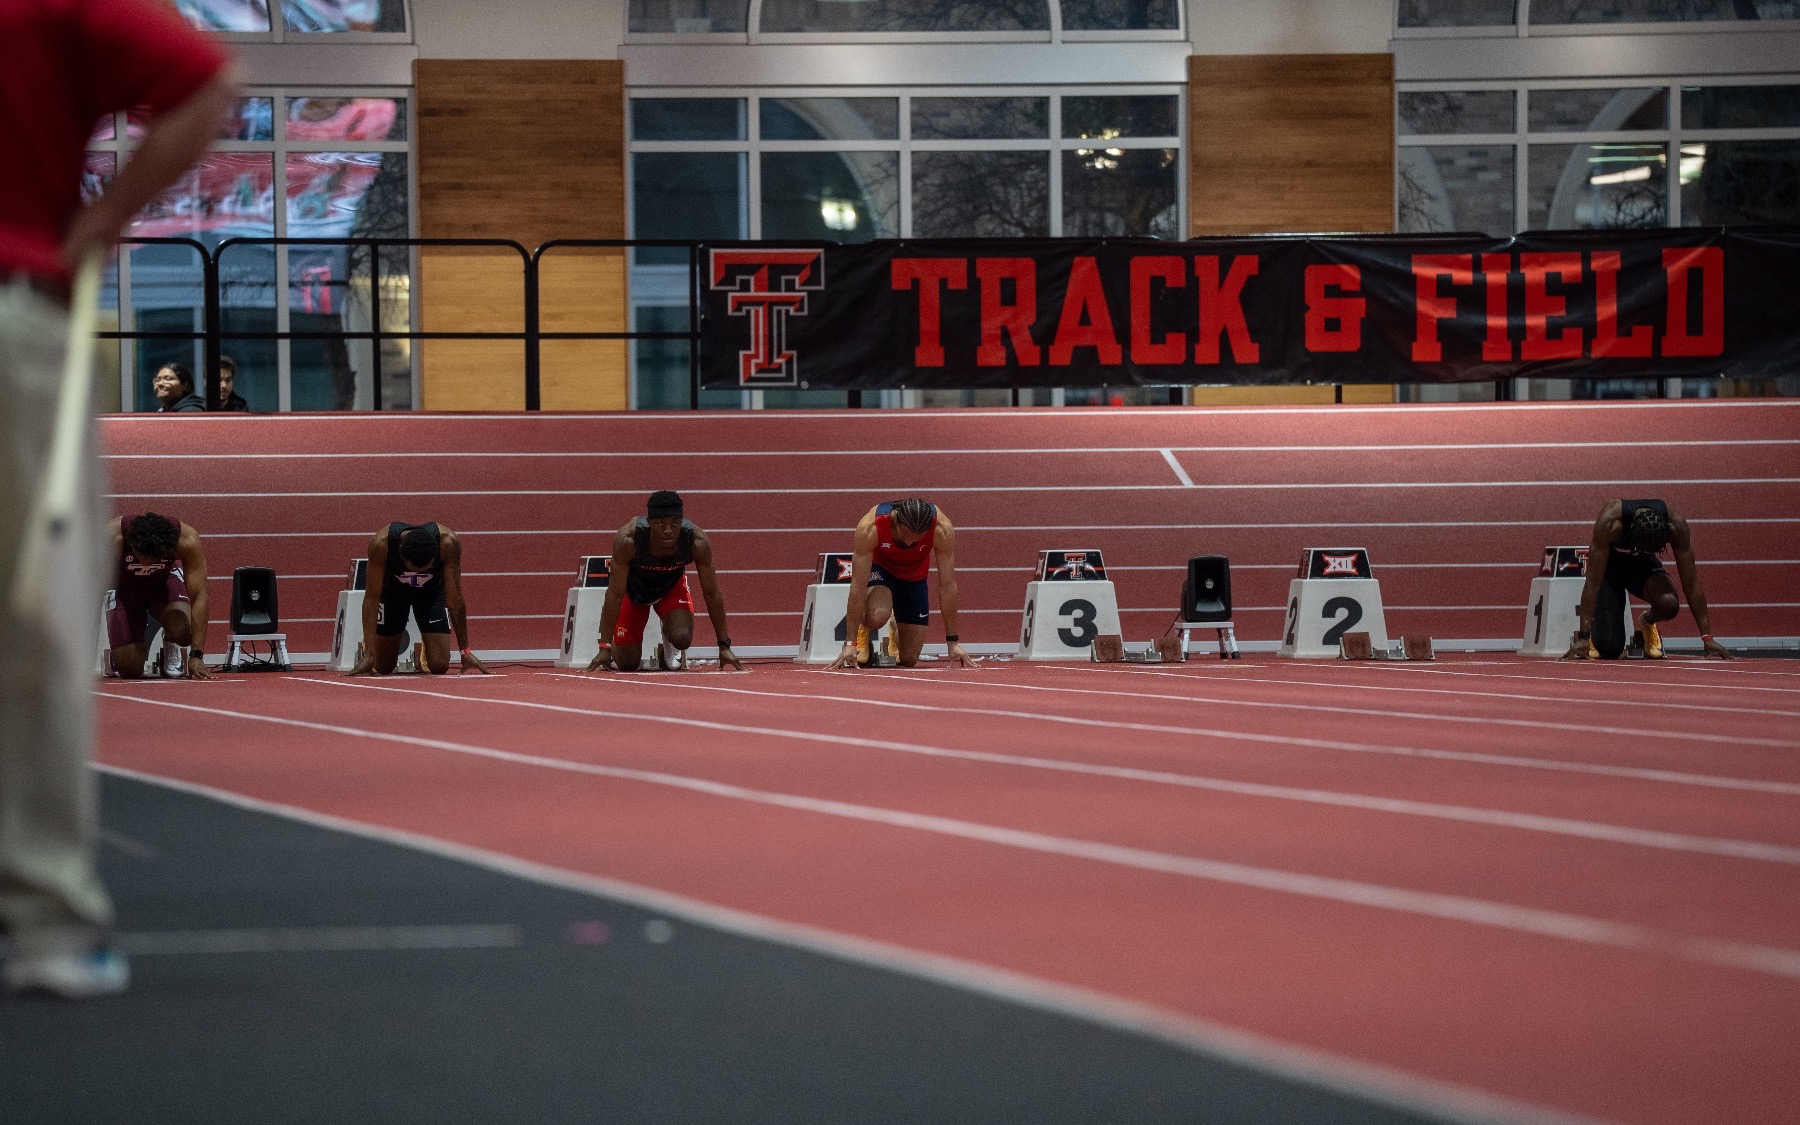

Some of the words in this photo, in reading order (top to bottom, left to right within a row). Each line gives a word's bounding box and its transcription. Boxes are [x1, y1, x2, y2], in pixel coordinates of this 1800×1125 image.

[890, 254, 1260, 367] TRACK
[1304, 263, 1366, 353] &
[1411, 245, 1724, 363] FIELD
[564, 605, 576, 654] 5
[803, 602, 813, 651] 4
[1023, 598, 1034, 649] 3
[1057, 598, 1099, 648] 3
[1285, 596, 1298, 646] 2
[1322, 596, 1363, 646] 2
[1534, 595, 1544, 645] 1
